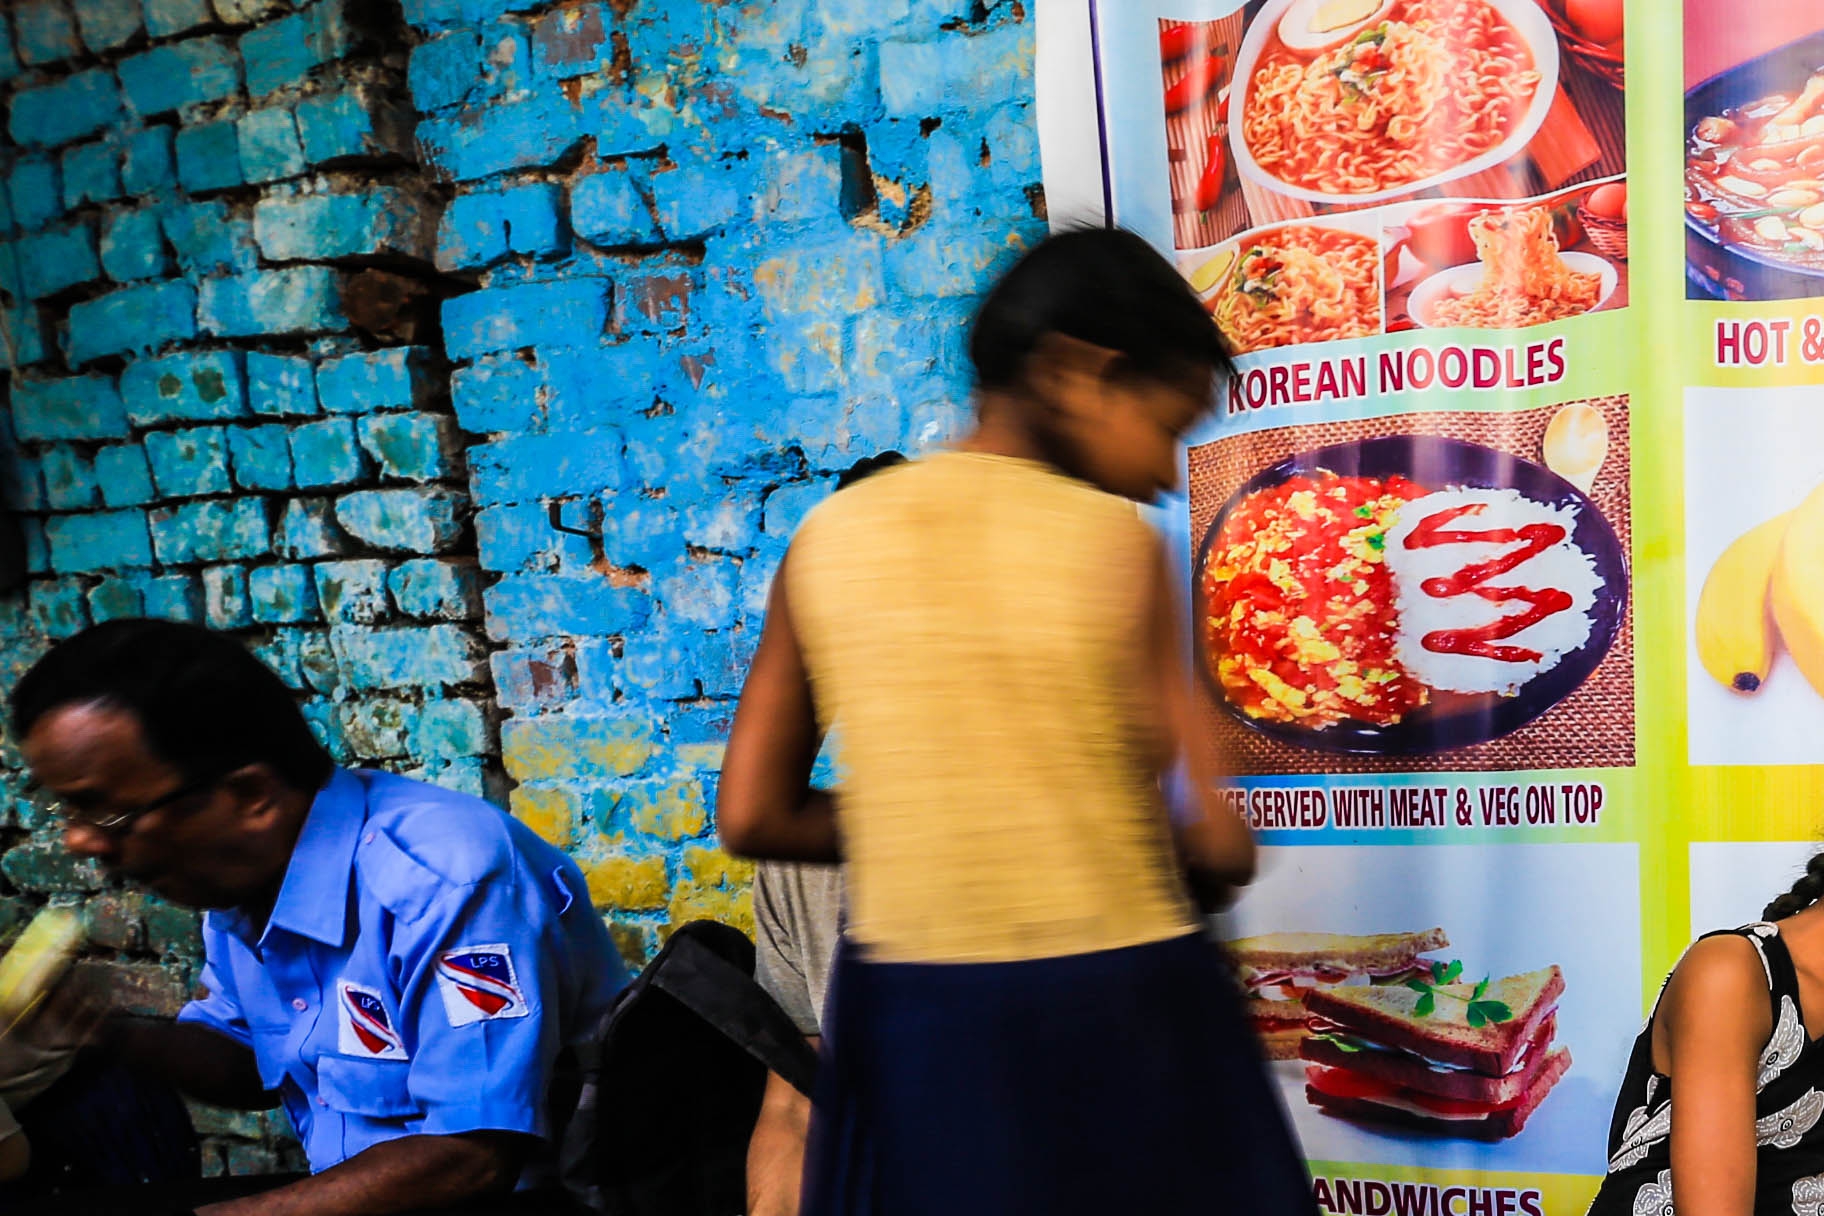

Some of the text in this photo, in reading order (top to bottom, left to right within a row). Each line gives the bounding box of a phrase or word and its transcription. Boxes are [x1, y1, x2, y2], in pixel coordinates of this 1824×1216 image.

[1717, 321, 1789, 364] HOT
[1228, 339, 1565, 414] KOREAN NOODLES
[1252, 791, 1326, 827] SERVED
[1333, 790, 1383, 826] WITH
[1390, 788, 1446, 826] MEAT
[1456, 788, 1472, 825] &
[1479, 787, 1519, 825] VEG
[1526, 786, 1554, 824] ON
[1562, 785, 1602, 823] TOP
[470, 956, 499, 968] LPS
